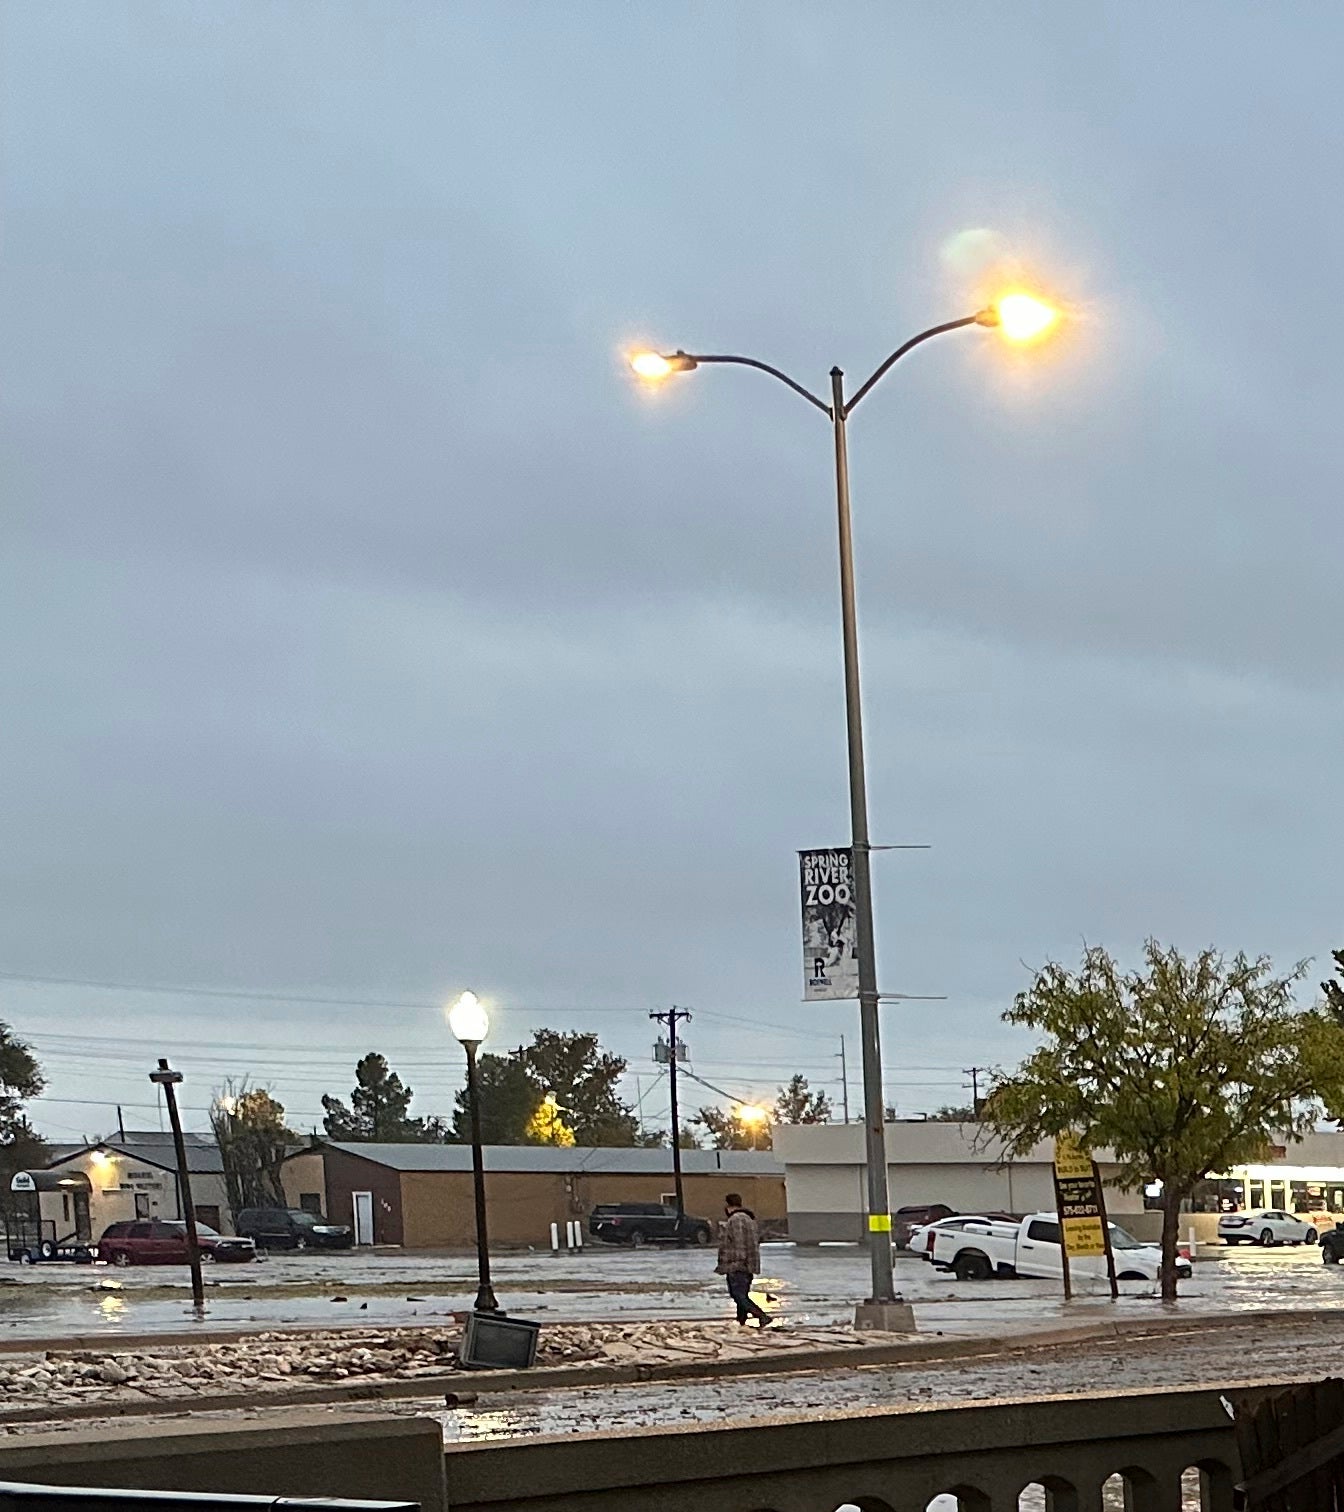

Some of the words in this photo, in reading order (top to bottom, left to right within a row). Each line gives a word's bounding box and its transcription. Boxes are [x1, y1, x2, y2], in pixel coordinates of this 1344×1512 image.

[804, 854, 849, 868] SPRING
[804, 867, 849, 885] RIVER
[805, 884, 851, 906] ZOO
